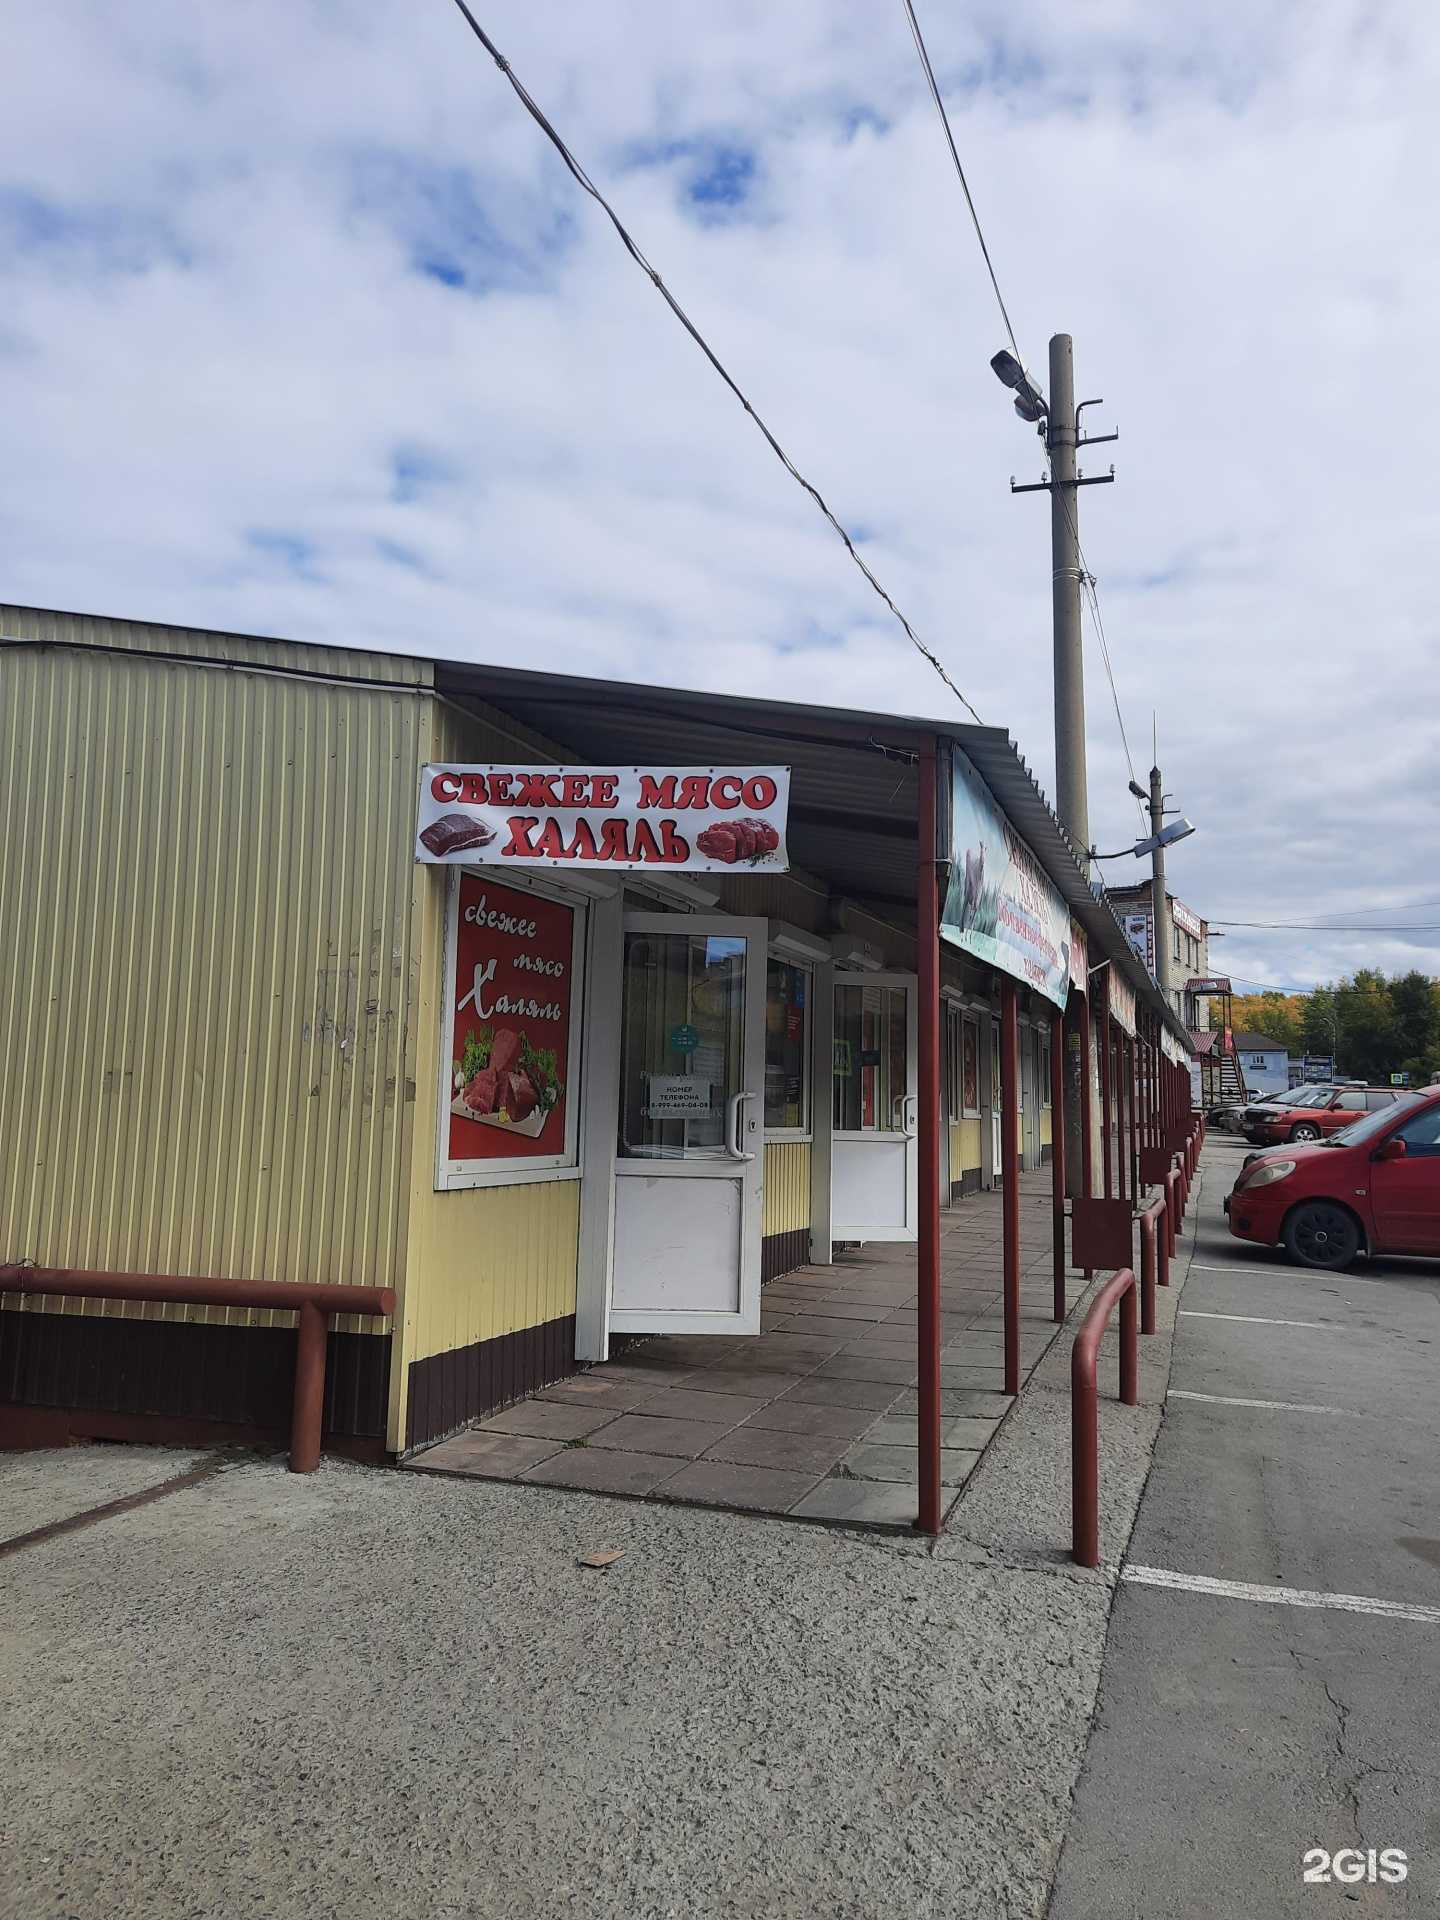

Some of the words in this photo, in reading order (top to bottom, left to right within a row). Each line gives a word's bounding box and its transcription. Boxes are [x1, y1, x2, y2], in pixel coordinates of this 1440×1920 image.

[431, 773, 619, 809] СВЕЖЕЕ
[636, 775, 777, 810] МЯСО
[501, 816, 690, 863] ХАЛЯЛЬ
[464, 894, 537, 938] свежее
[513, 952, 564, 978] мясо
[457, 959, 562, 1020] Халяль
